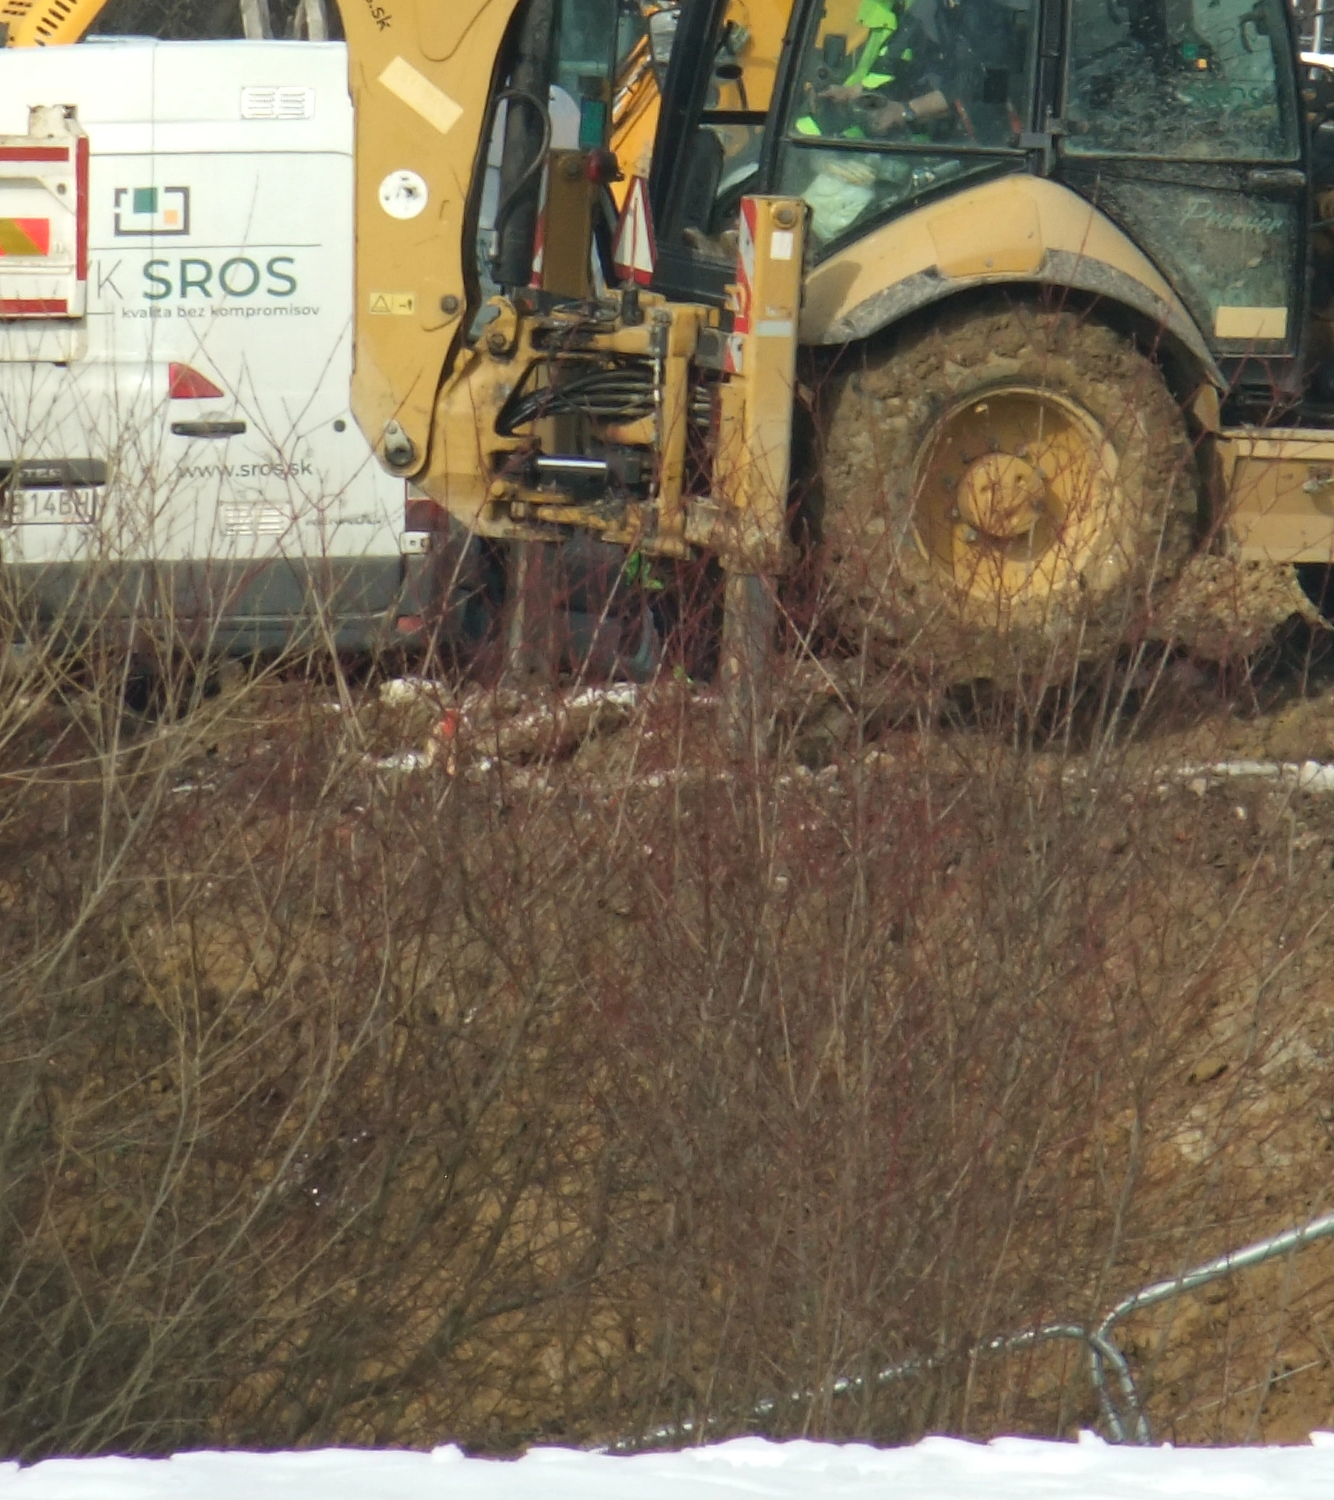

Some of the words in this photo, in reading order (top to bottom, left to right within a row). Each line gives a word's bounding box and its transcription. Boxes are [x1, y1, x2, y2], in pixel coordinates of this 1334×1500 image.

[88, 260, 123, 300] K
[142, 256, 298, 300] SROS
[177, 305, 205, 318] bez
